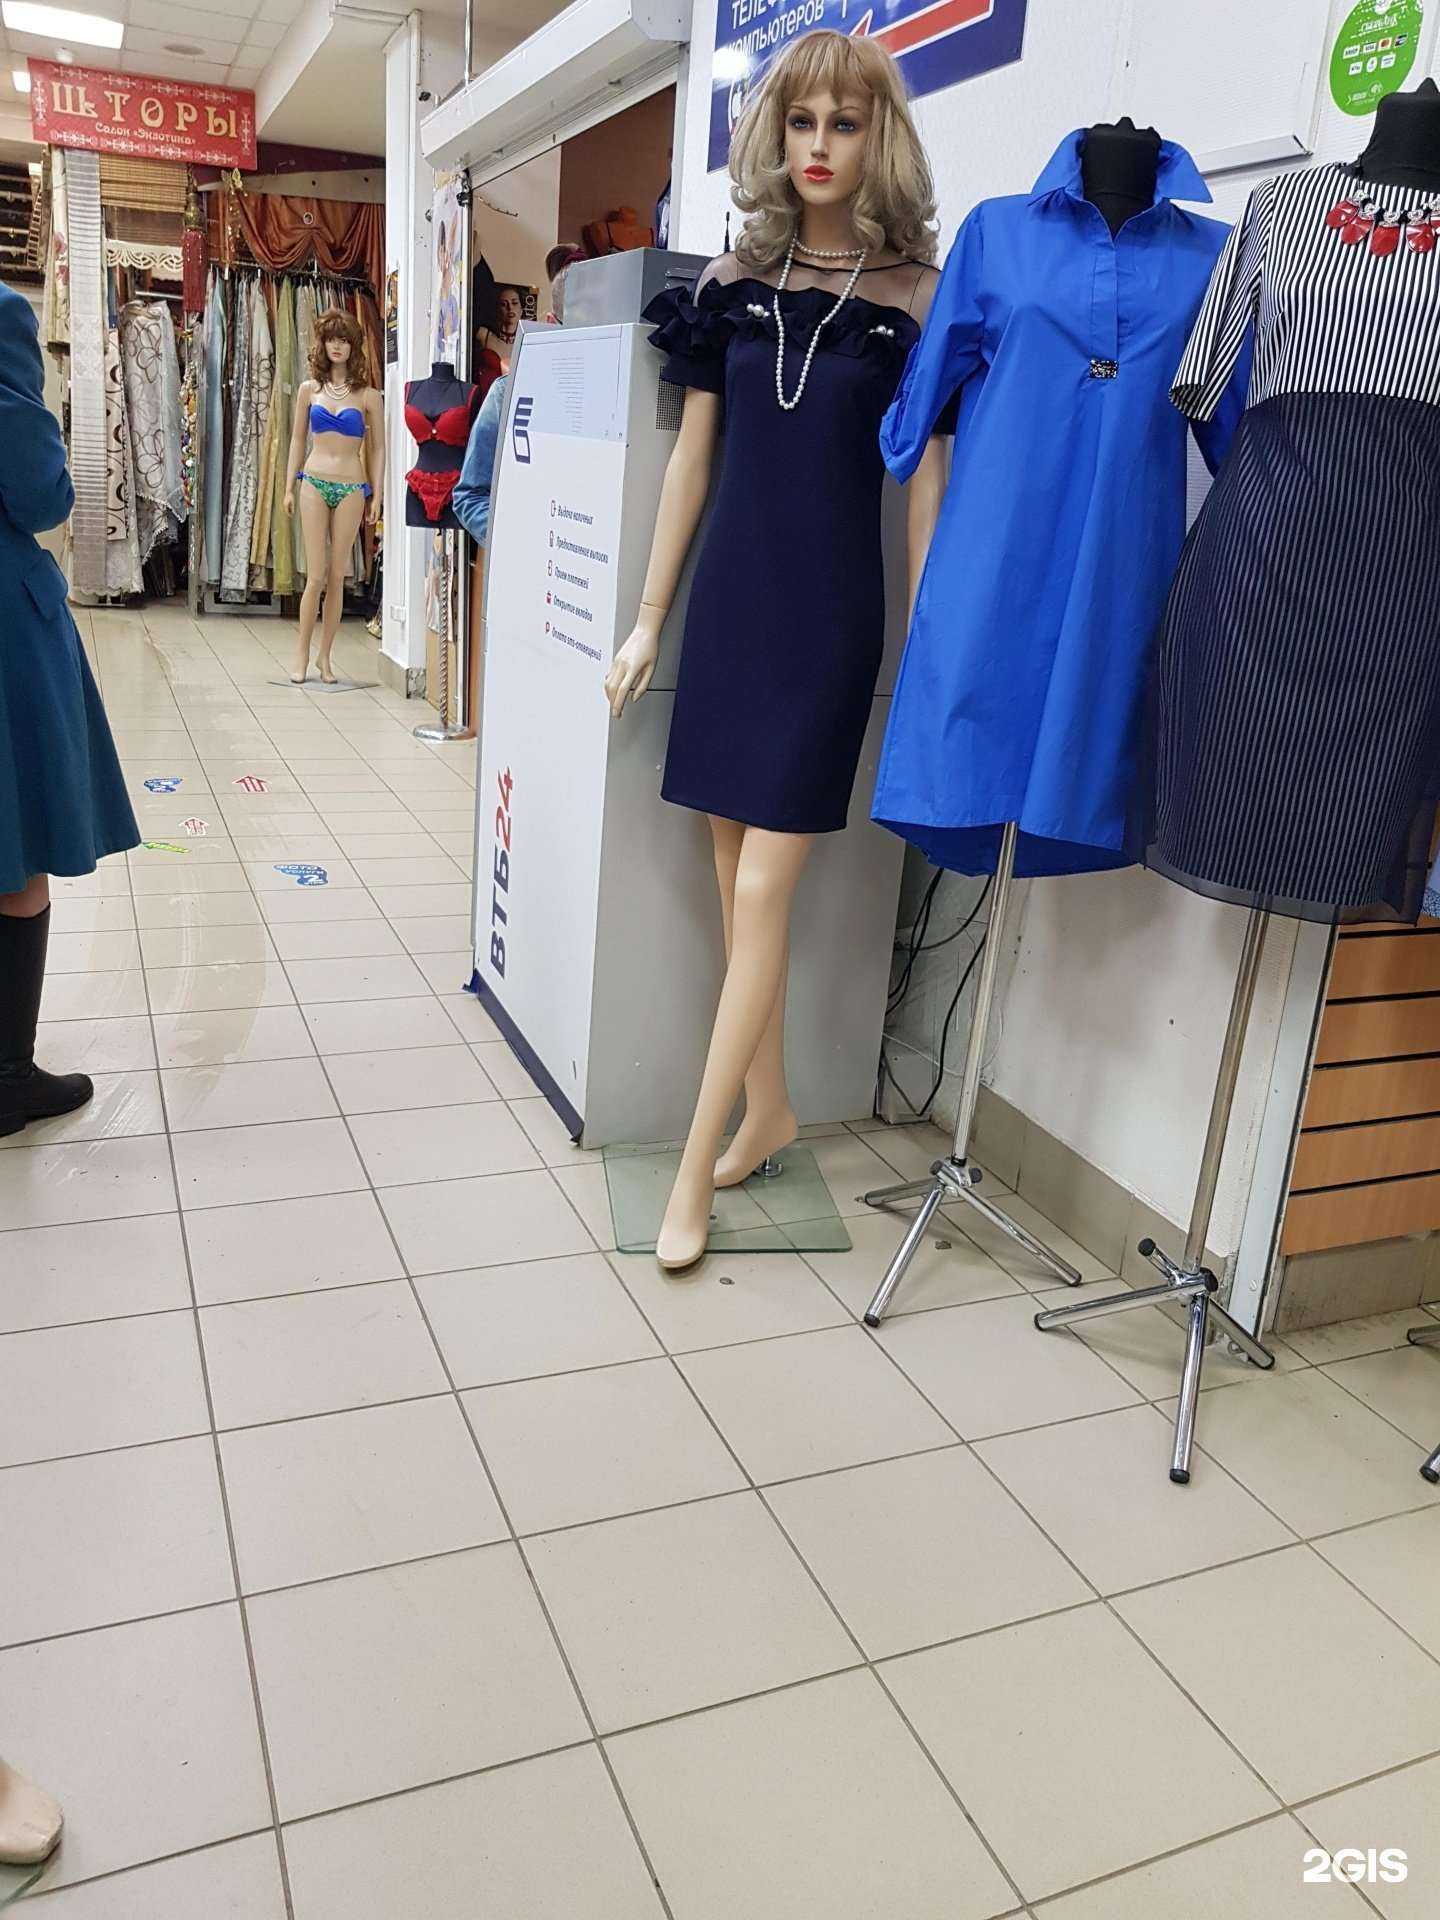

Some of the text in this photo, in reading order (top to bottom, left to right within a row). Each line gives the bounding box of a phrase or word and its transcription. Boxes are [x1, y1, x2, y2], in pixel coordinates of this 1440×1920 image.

[95, 121, 130, 137] Салон
[558, 505, 573, 519] Выдача
[553, 594, 575, 614] Открытие
[552, 626, 567, 643] Оплата
[490, 766, 513, 980] ВТБ24
